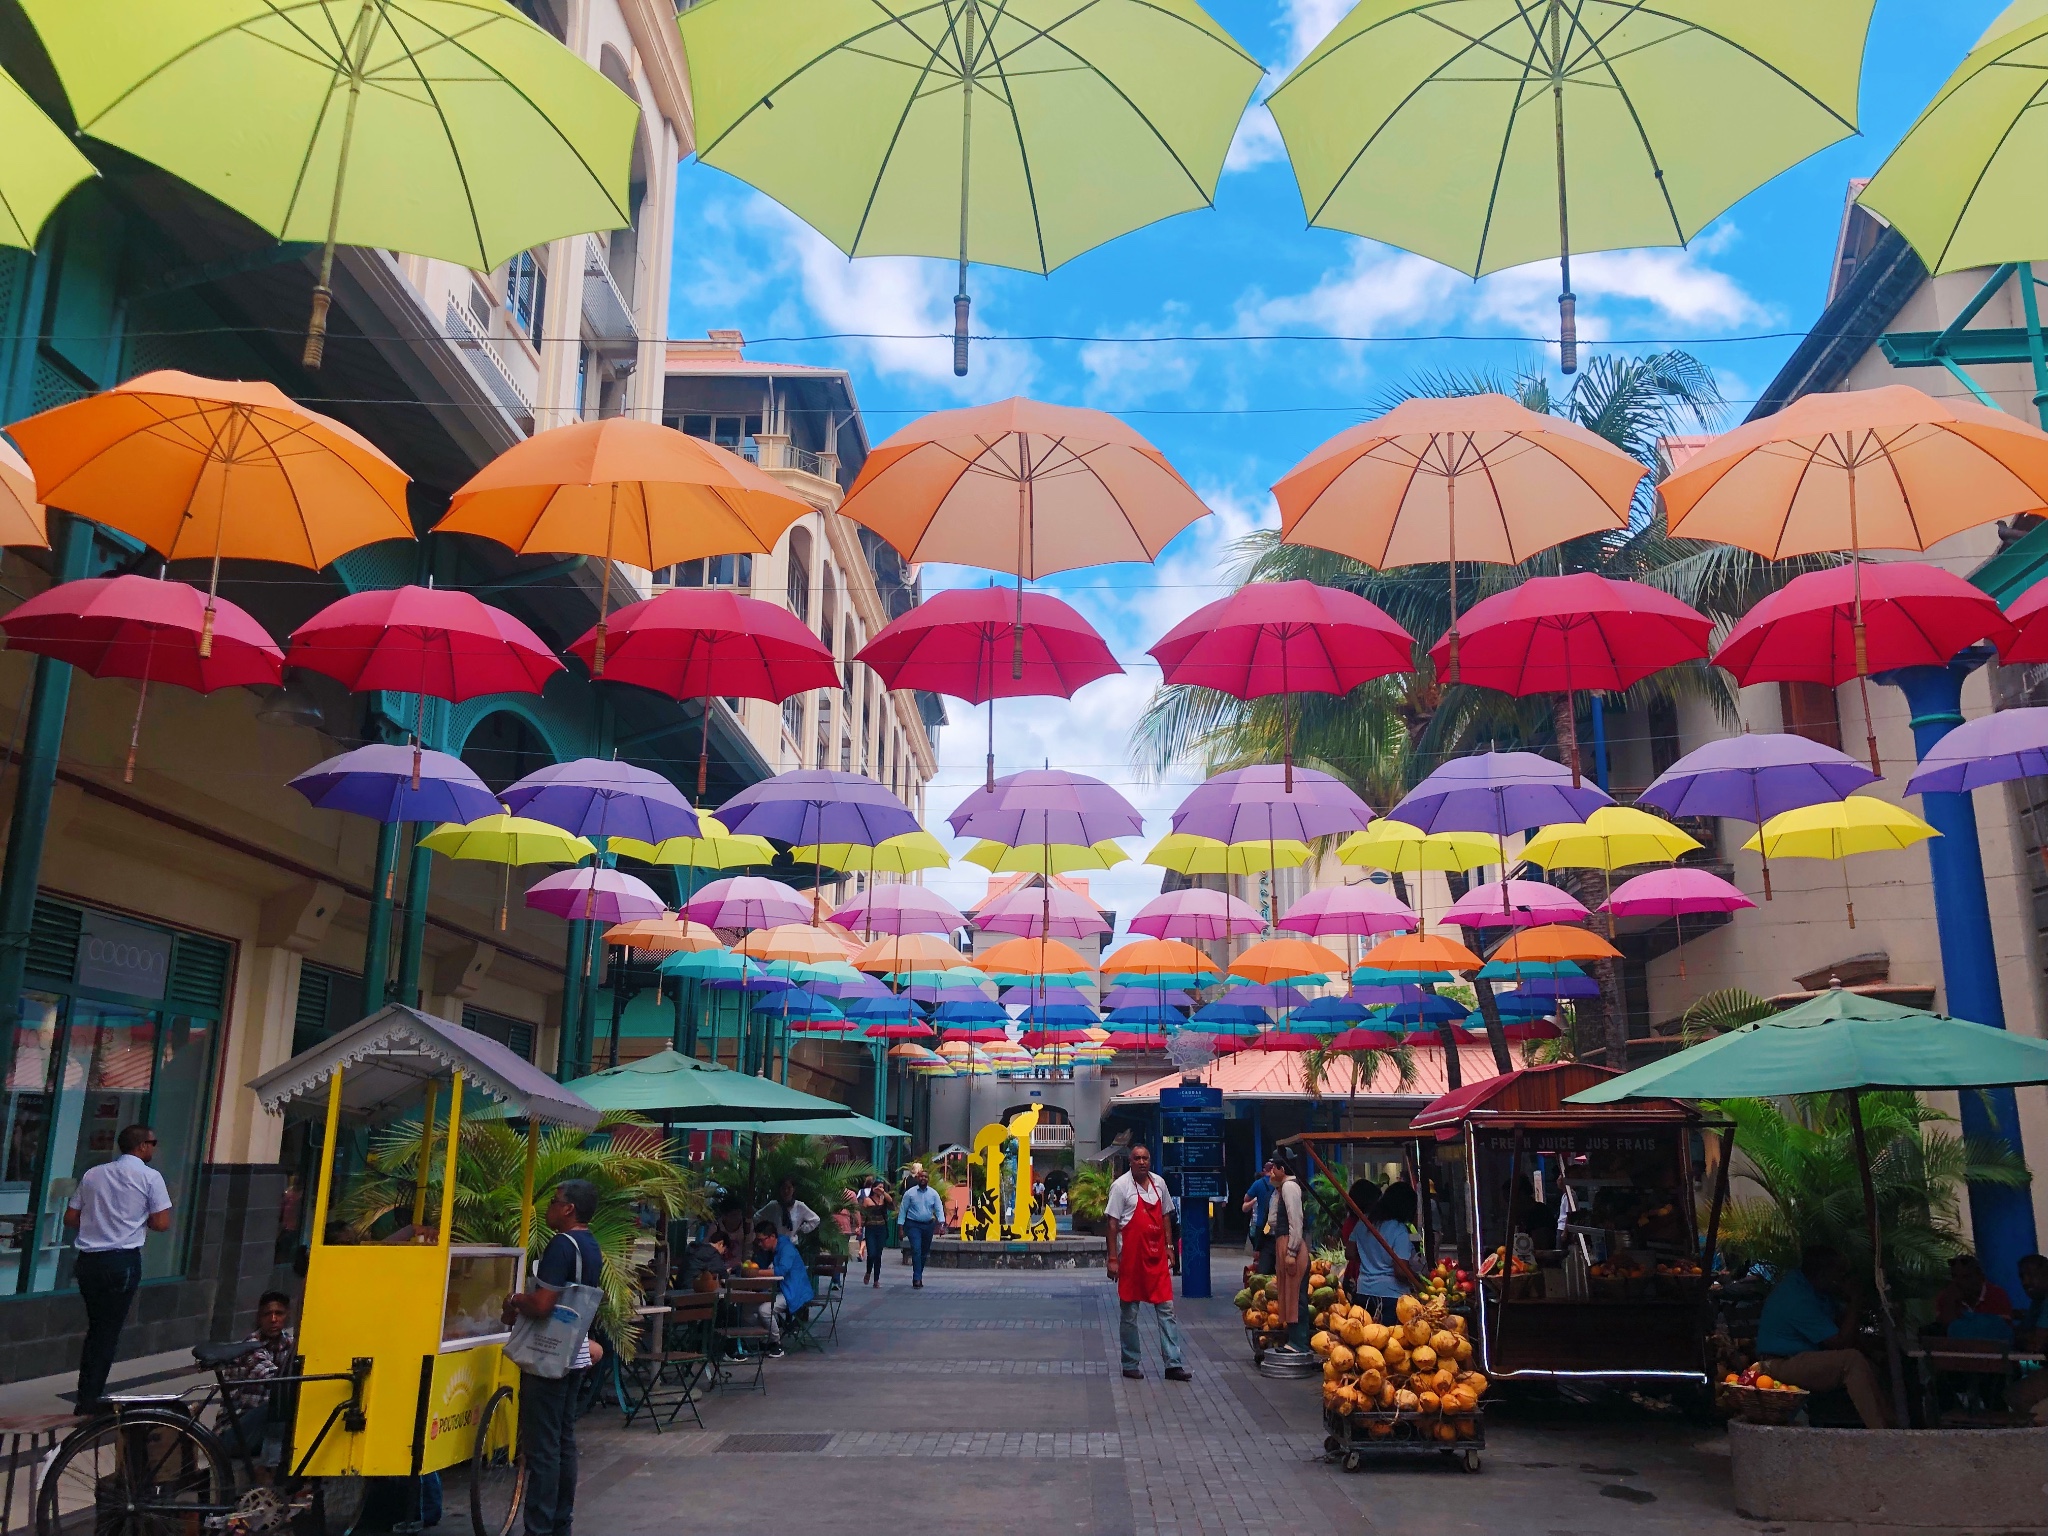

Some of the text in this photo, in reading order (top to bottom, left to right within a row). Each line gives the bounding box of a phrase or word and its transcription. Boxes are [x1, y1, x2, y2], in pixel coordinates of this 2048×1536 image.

[90, 939, 164, 974] cocoon
[1490, 1136, 1656, 1151] FREH JUICE JUS FRAIS
